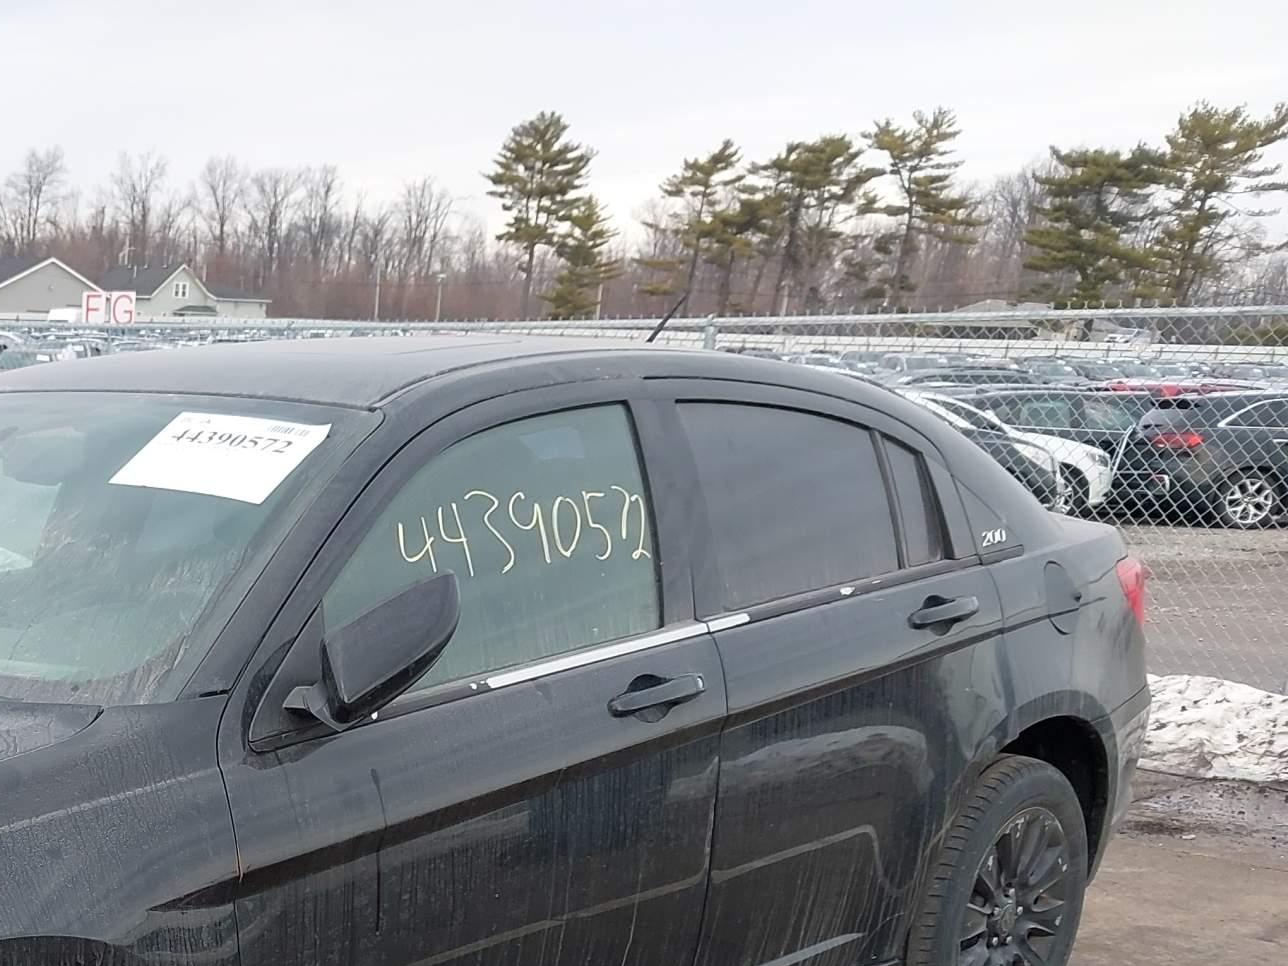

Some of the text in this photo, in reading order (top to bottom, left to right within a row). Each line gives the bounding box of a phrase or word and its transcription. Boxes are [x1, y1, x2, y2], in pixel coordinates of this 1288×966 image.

[170, 428, 295, 454] 44390572
[396, 485, 652, 578] 44390572
[981, 527, 1007, 547] 200
